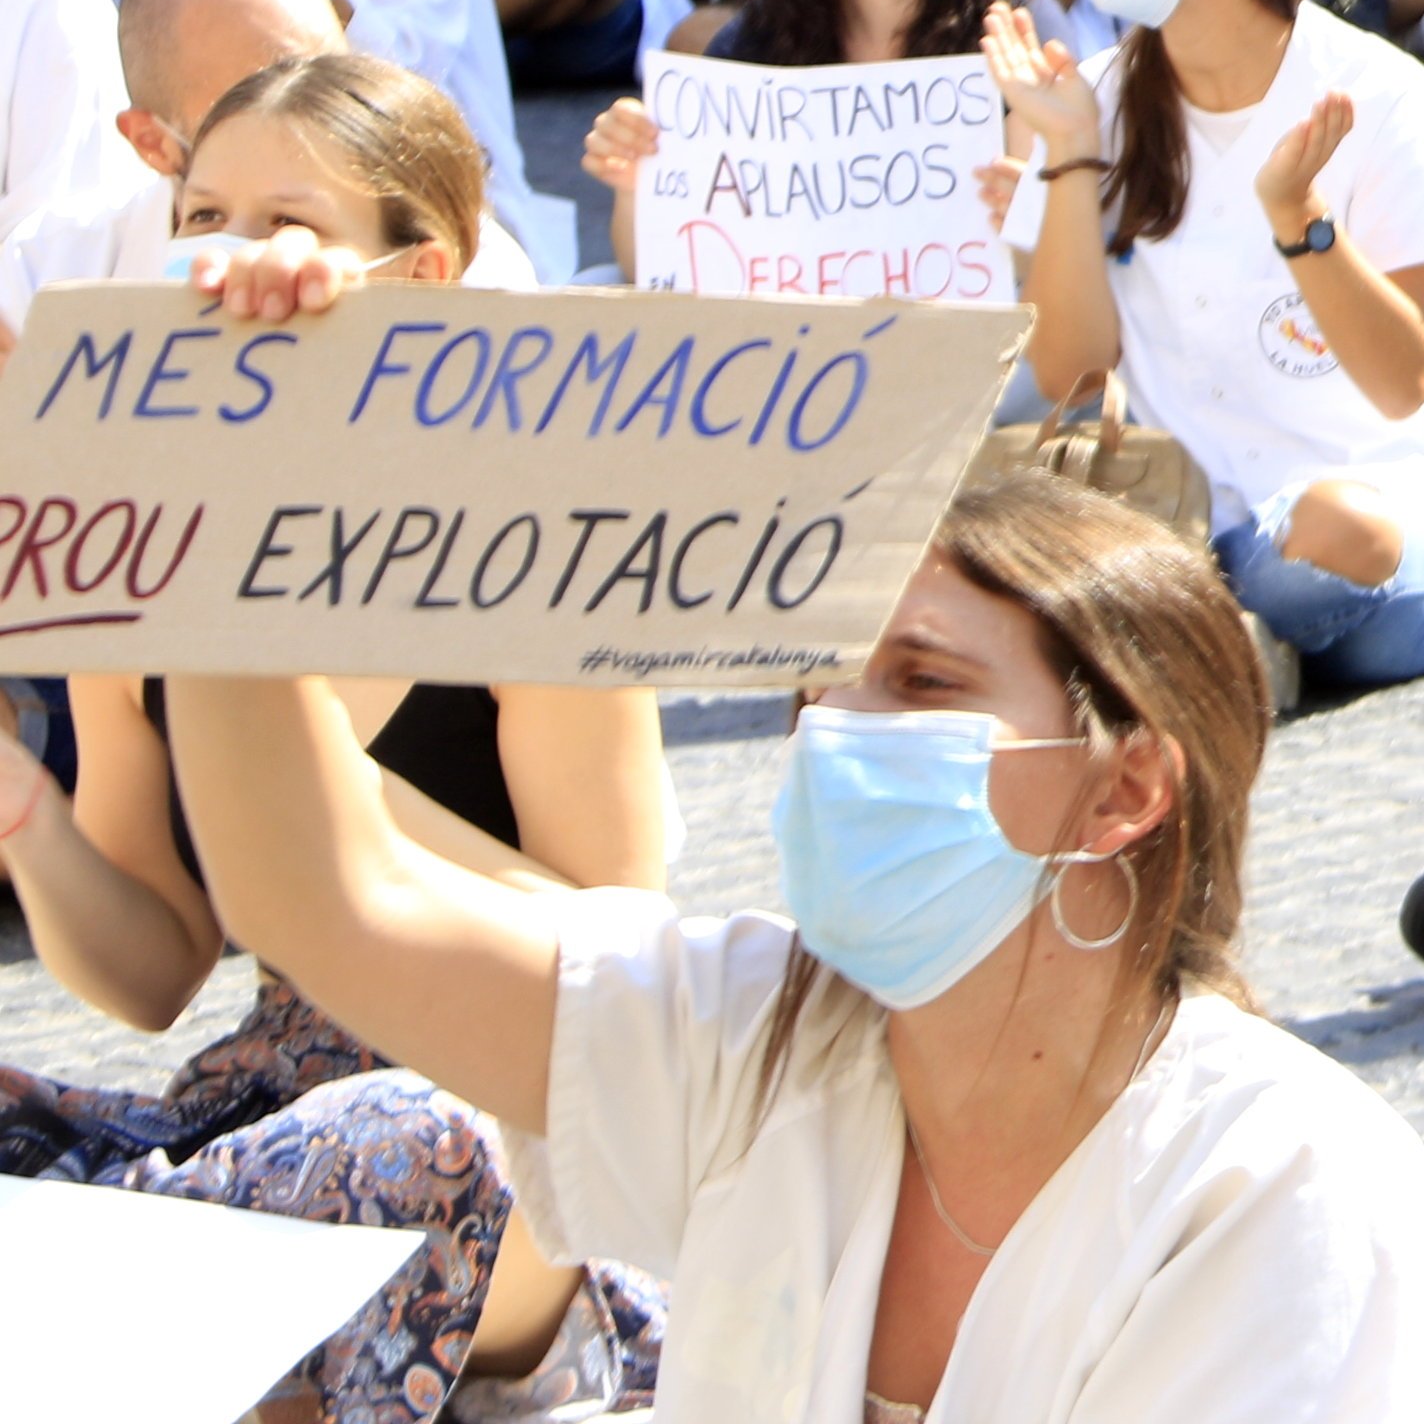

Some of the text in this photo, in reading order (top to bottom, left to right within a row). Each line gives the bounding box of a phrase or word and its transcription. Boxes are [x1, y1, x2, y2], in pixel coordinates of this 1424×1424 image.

[653, 142, 958, 221] LOS APLAUSOS
[677, 219, 993, 299] DERECHOS
[36, 304, 898, 454] MÉS FORMACIÓ
[236, 478, 874, 616] EXPLOTACIÓ
